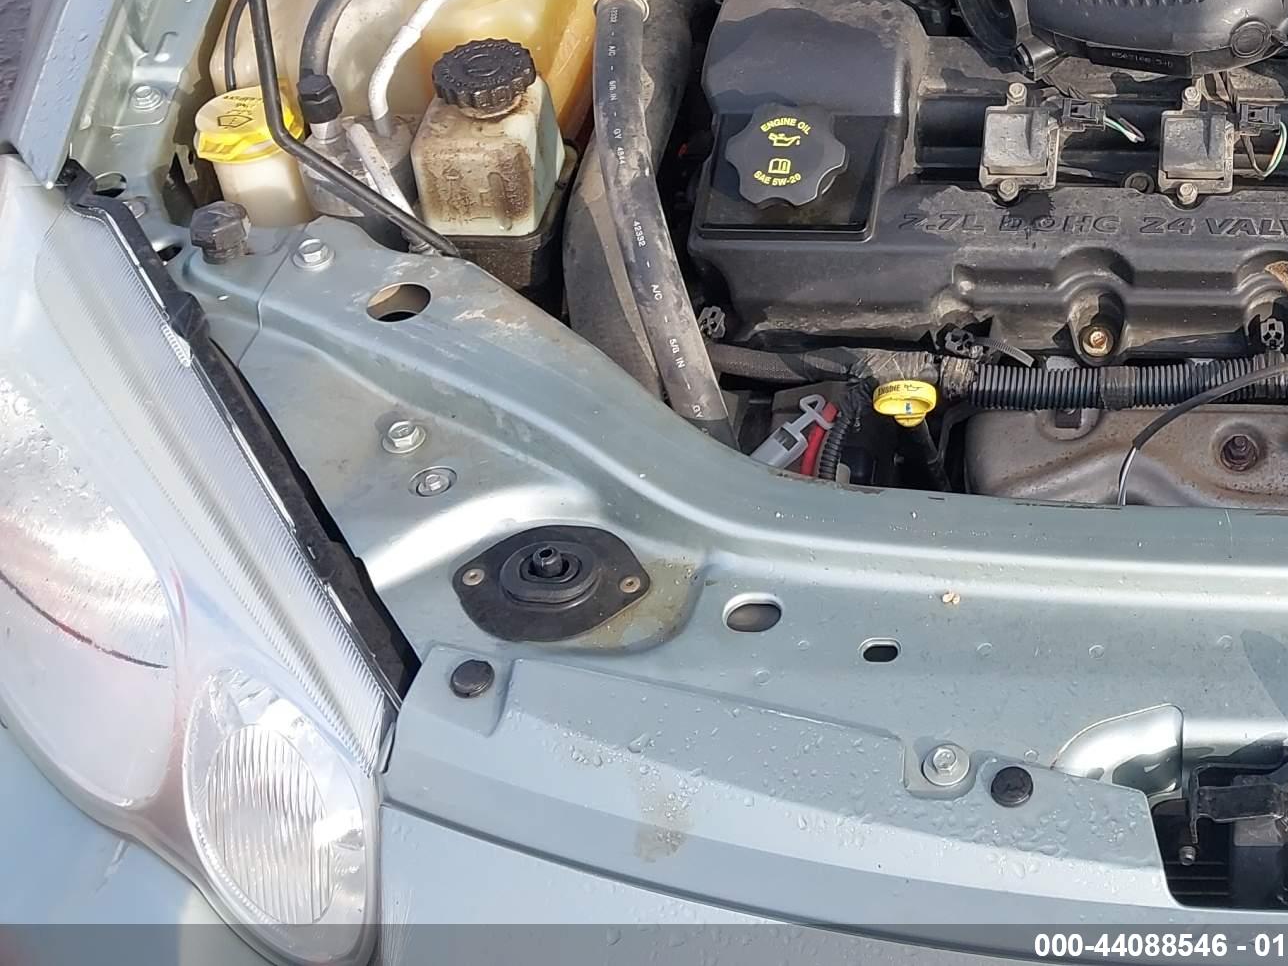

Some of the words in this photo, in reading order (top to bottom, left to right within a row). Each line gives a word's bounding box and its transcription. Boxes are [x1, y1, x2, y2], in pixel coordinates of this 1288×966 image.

[759, 117, 797, 132] ENGINE
[797, 121, 811, 135] OIL
[753, 170, 770, 184] SAE
[771, 173, 802, 187] 5W-20
[1140, 216, 1196, 235] 24
[632, 219, 647, 248] 42332
[650, 284, 664, 302] A/C
